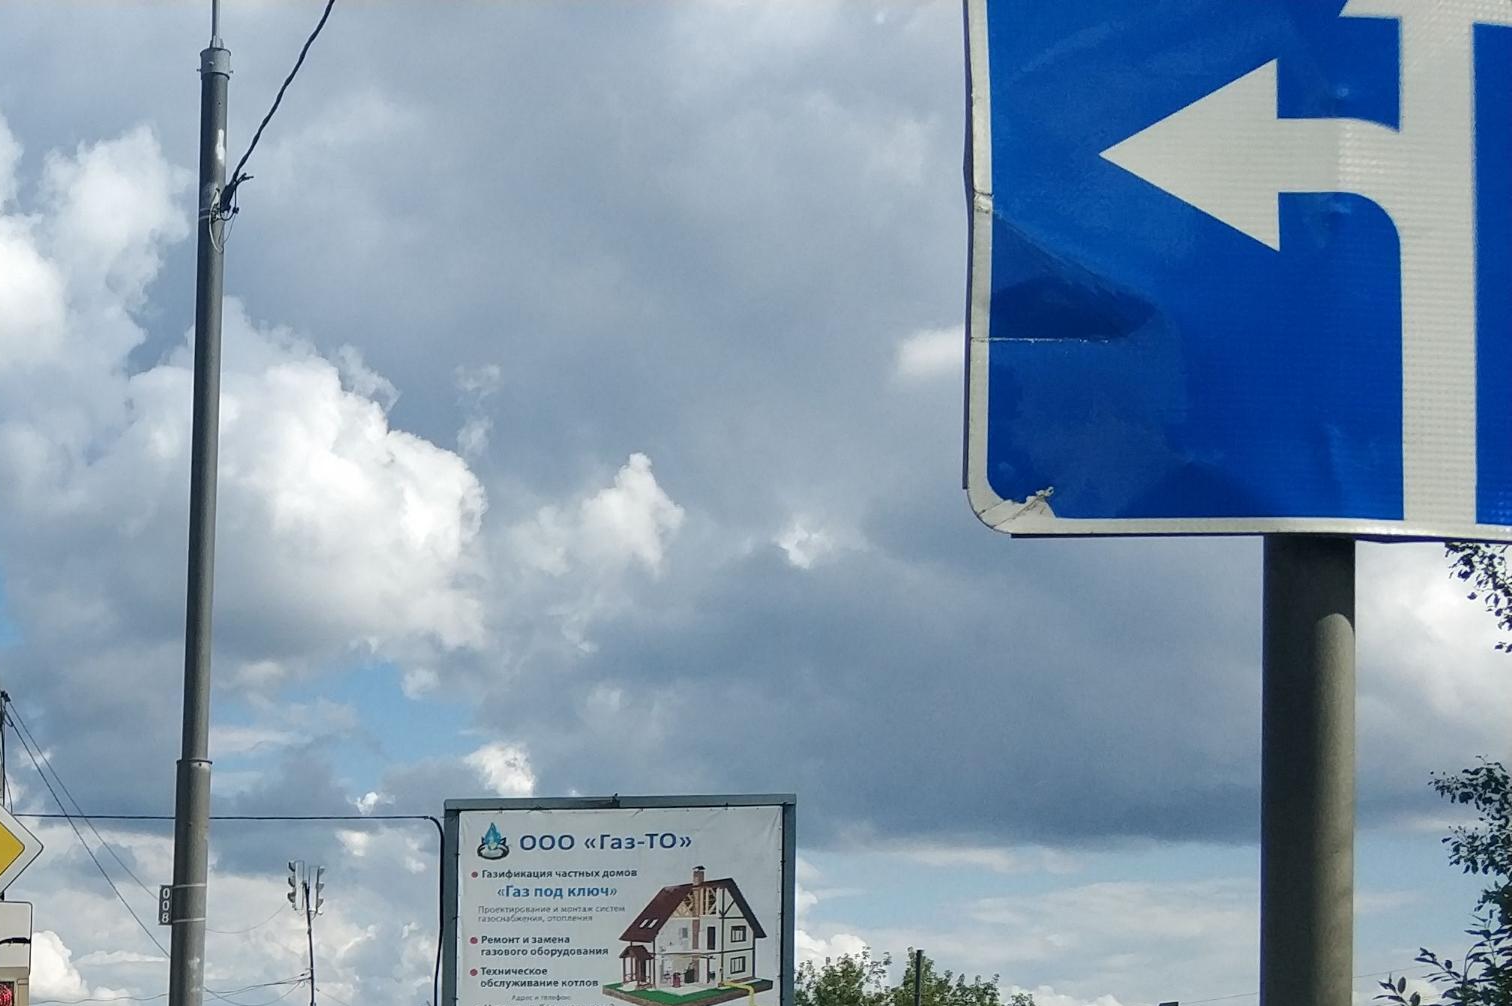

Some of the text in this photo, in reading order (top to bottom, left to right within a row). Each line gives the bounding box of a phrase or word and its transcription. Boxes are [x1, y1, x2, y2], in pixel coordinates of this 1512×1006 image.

[519, 832, 693, 851] ООО «Газ-ТО»
[481, 869, 638, 879] Газификация частных домов
[497, 885, 618, 899] «Газ под ключ»
[161, 887, 170, 923] 008
[481, 936, 520, 944] Ремонт
[480, 947, 609, 957] газового оборудования
[480, 967, 548, 976] Техническое
[480, 979, 599, 989] обслуживание котлов
